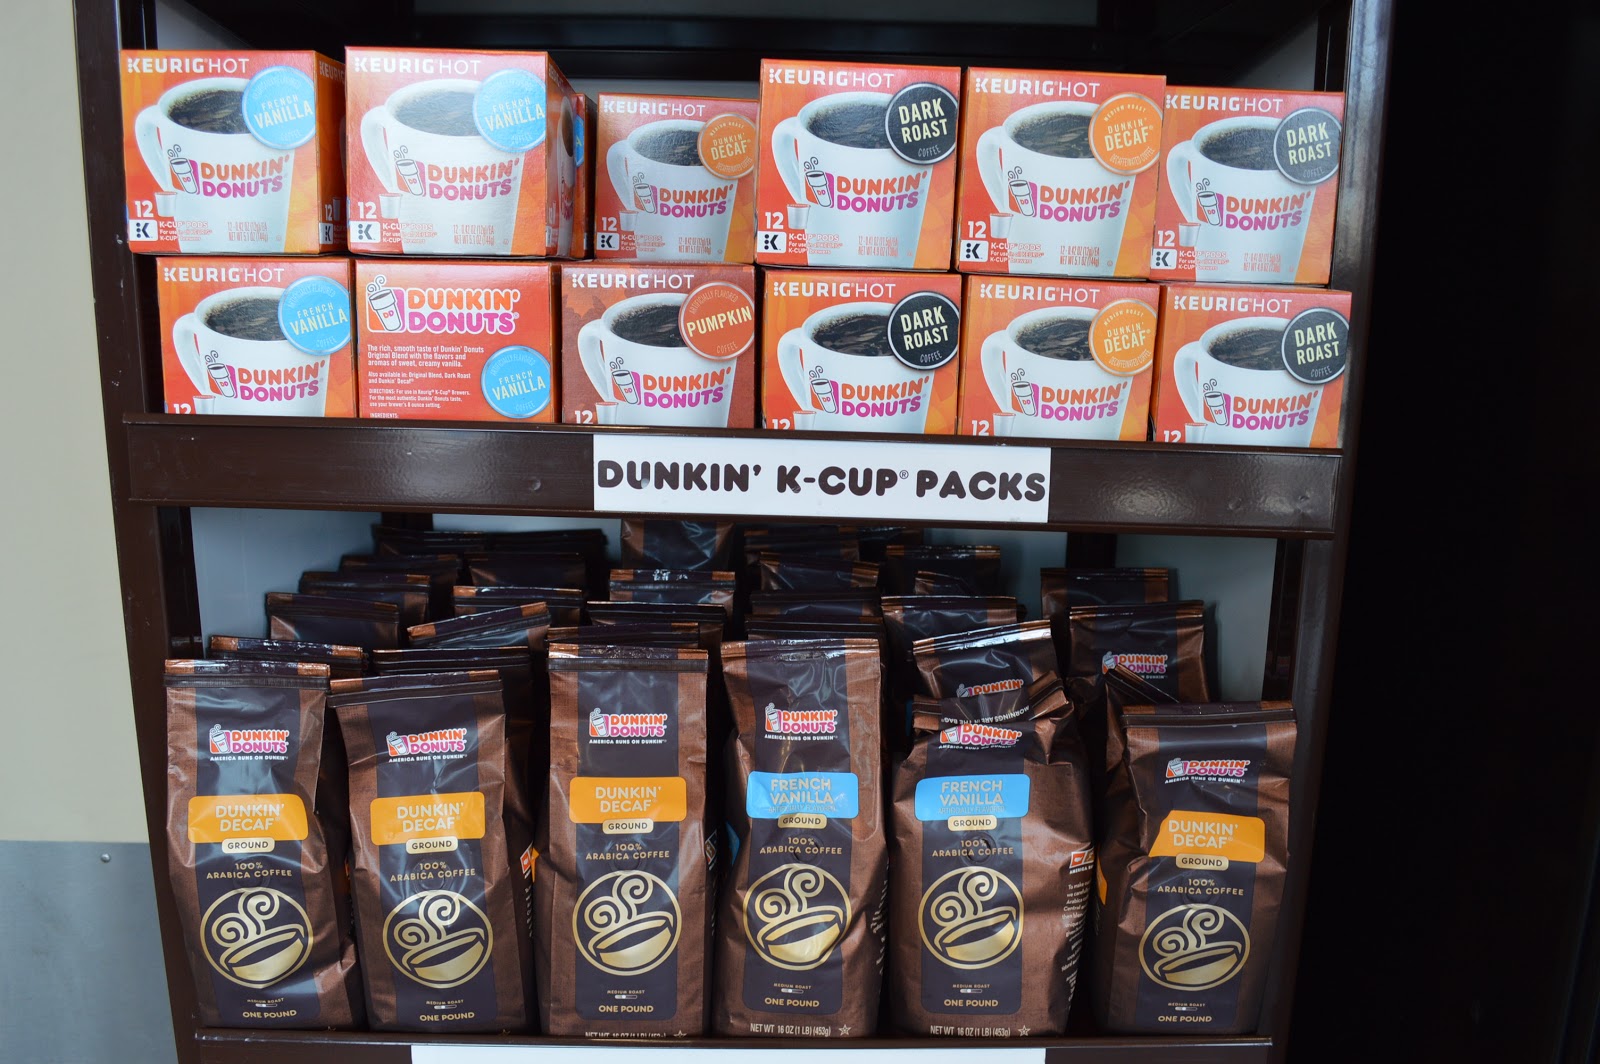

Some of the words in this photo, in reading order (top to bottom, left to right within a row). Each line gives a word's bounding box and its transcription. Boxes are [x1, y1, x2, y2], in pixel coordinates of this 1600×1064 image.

[261, 94, 298, 112] FRENCH
[899, 98, 945, 125] DARK
[254, 100, 313, 129] VANILLA
[484, 103, 546, 132] VANILLA
[901, 119, 948, 143] ROAST
[1286, 122, 1329, 147] DARK
[1289, 142, 1331, 165] ROAST
[201, 154, 290, 180] DUNKIN'
[428, 158, 520, 183] DUNKIN'
[203, 176, 283, 198] DONUTS
[429, 179, 512, 200] DONUTS
[837, 171, 928, 195] DUNKIN'
[659, 184, 733, 204] DUNKIN'
[1040, 180, 1130, 205] DUNKIN'
[135, 200, 153, 218] 12
[660, 201, 726, 218] DONUTS
[837, 191, 919, 212] DONUTS
[1226, 191, 1311, 214] DUNKIN'
[1040, 201, 1120, 222] DONUTS
[602, 217, 617, 231] 12
[1226, 210, 1302, 231] DONUTS
[968, 221, 986, 238] 12
[407, 288, 520, 311] DUNKIN'
[297, 302, 334, 318] FRENCH
[290, 308, 348, 335] VANILLA
[408, 312, 515, 334] DONUTS
[687, 306, 752, 337] PUMPKIN
[901, 306, 945, 332] DARK
[904, 326, 949, 350] ROAST
[1295, 322, 1337, 347] DARK
[1297, 342, 1339, 365] ROAST
[238, 360, 325, 385] DUNKIN'
[499, 370, 533, 385] FRENCH
[643, 367, 732, 391] DUNKIN'
[240, 380, 319, 401] DONUTS
[492, 375, 546, 400] VANILLA
[841, 376, 929, 400] DUNKIN'
[1041, 382, 1127, 405] DUNKIN'
[644, 387, 723, 408] DONUTS
[1233, 391, 1318, 414] DUNKIN'
[842, 396, 922, 417] DONUTS
[1041, 401, 1118, 421] DONUTS
[1233, 410, 1309, 430] DONUTS
[598, 459, 762, 492] DUNKIN'
[916, 470, 1046, 502] PACKS
[611, 714, 667, 725] DUNKIN'
[782, 710, 838, 721] DUNKIN'
[232, 730, 289, 742] DUNKIN'
[409, 729, 467, 742] DUNKIN'
[611, 726, 665, 737] DONUTS
[783, 722, 835, 733] DONUTS
[962, 724, 1022, 740] DUNKIN'
[232, 742, 288, 753] DONUTS
[410, 740, 465, 753] DONUTS
[1187, 768, 1246, 777] DONUTS
[1189, 760, 1250, 768] DUNKIN'
[595, 786, 662, 799] DUNKIN'
[771, 778, 831, 790] FRENCH
[942, 780, 1002, 793] FRENCH
[770, 791, 833, 804] VANILLA
[940, 794, 1003, 806] VANILLA
[216, 804, 284, 818] DUNKIN'
[397, 802, 464, 819] DUNKIN'
[783, 817, 821, 825] GROUND
[953, 819, 991, 827] GROUND
[1169, 820, 1238, 836] DUNKIN'
[412, 841, 452, 849] GROUND
[788, 837, 815, 845] 100%
[633, 851, 670, 859] COFFEE
[760, 846, 801, 854] ARABICA
[235, 862, 263, 870] 100%
[420, 862, 446, 870] 100%
[1182, 857, 1222, 867] GROUND
[207, 871, 250, 879] ARABICA
[390, 872, 434, 882] ARABICA
[438, 869, 475, 878] COFFEE
[1189, 878, 1215, 886] 100%
[1158, 886, 1201, 894] ARABICA
[1206, 887, 1244, 896] COFFEE
[787, 999, 819, 1007] POUND
[265, 1010, 297, 1018] POUND
[442, 1012, 475, 1020] POUND
[751, 1023, 763, 1032] NET
[764, 1024, 774, 1033] WT
[778, 1025, 784, 1034] 16
[786, 1025, 794, 1034] OZ
